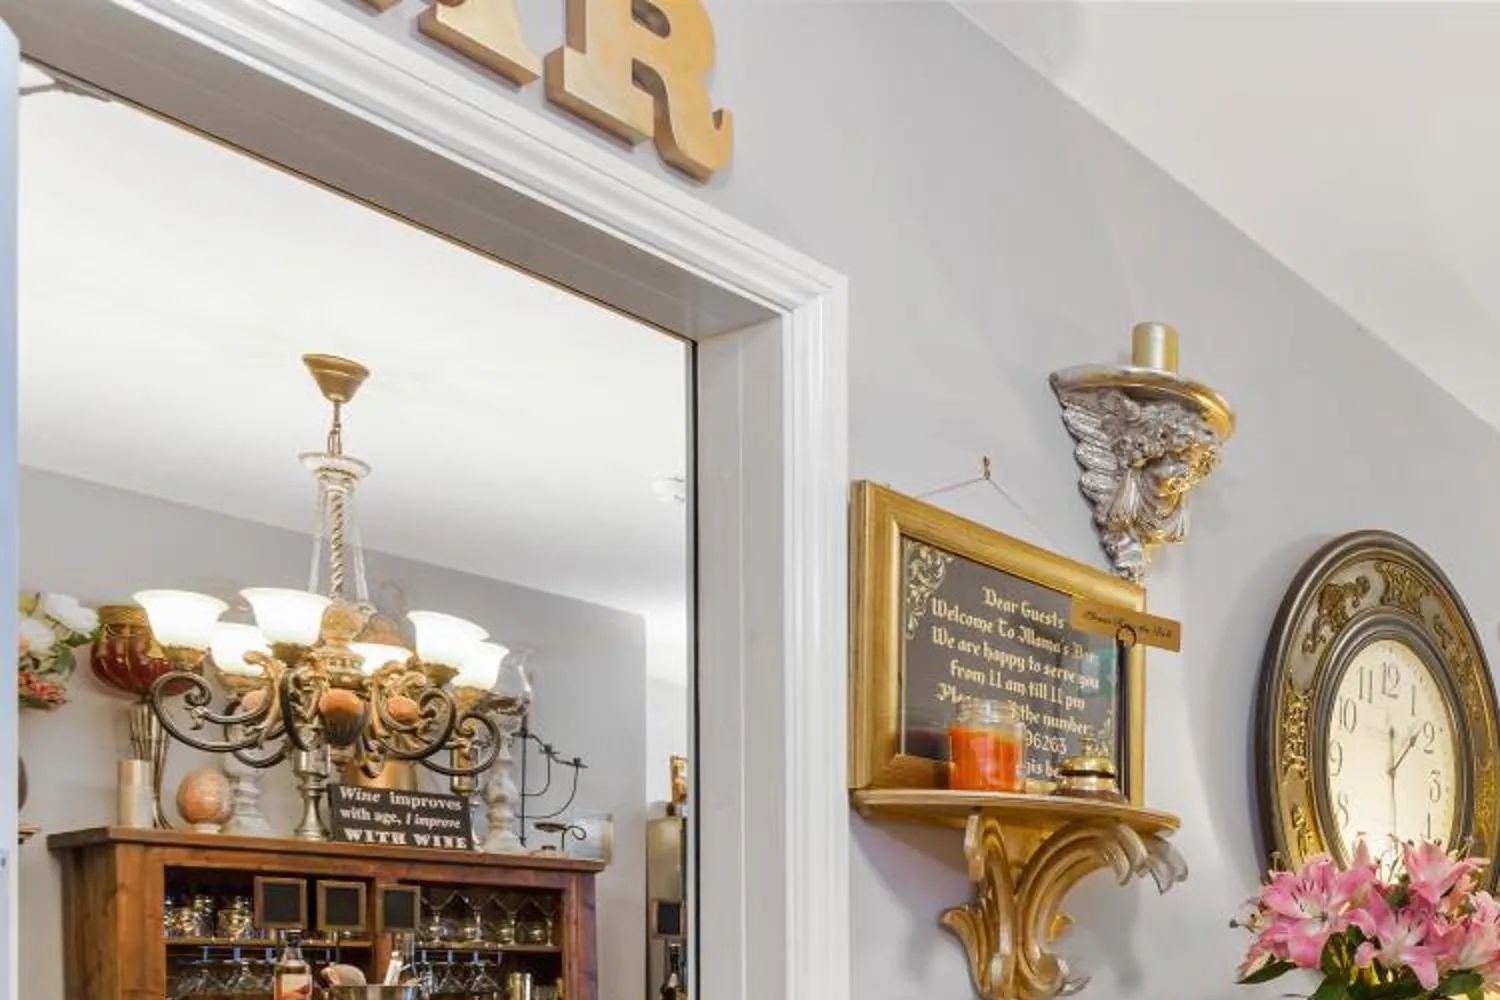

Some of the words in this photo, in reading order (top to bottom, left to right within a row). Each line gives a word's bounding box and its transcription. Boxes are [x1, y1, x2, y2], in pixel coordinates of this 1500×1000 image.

[931, 597, 994, 634] Welcome
[998, 618, 1015, 640] To
[981, 585, 1020, 614] Dear
[1021, 599, 1065, 630] Guests
[931, 626, 956, 650] We
[957, 639, 981, 657] are
[983, 641, 1025, 672] happy
[1028, 655, 1041, 672] to
[1043, 666, 1076, 683] serve
[1004, 680, 1026, 696] am
[1028, 680, 1047, 700] till
[1064, 696, 1085, 711] pm
[1358, 665, 1373, 704] 11
[1381, 661, 1400, 699] 12
[1339, 695, 1357, 733] 10
[1423, 720, 1436, 755] 2
[339, 785, 381, 803] Wine
[389, 791, 462, 811] improves
[1428, 768, 1442, 803] 3
[339, 806, 371, 821] with
[374, 812, 401, 826] age,
[414, 813, 461, 829] improve
[343, 828, 408, 845] WITH
[412, 832, 468, 849] WINE
